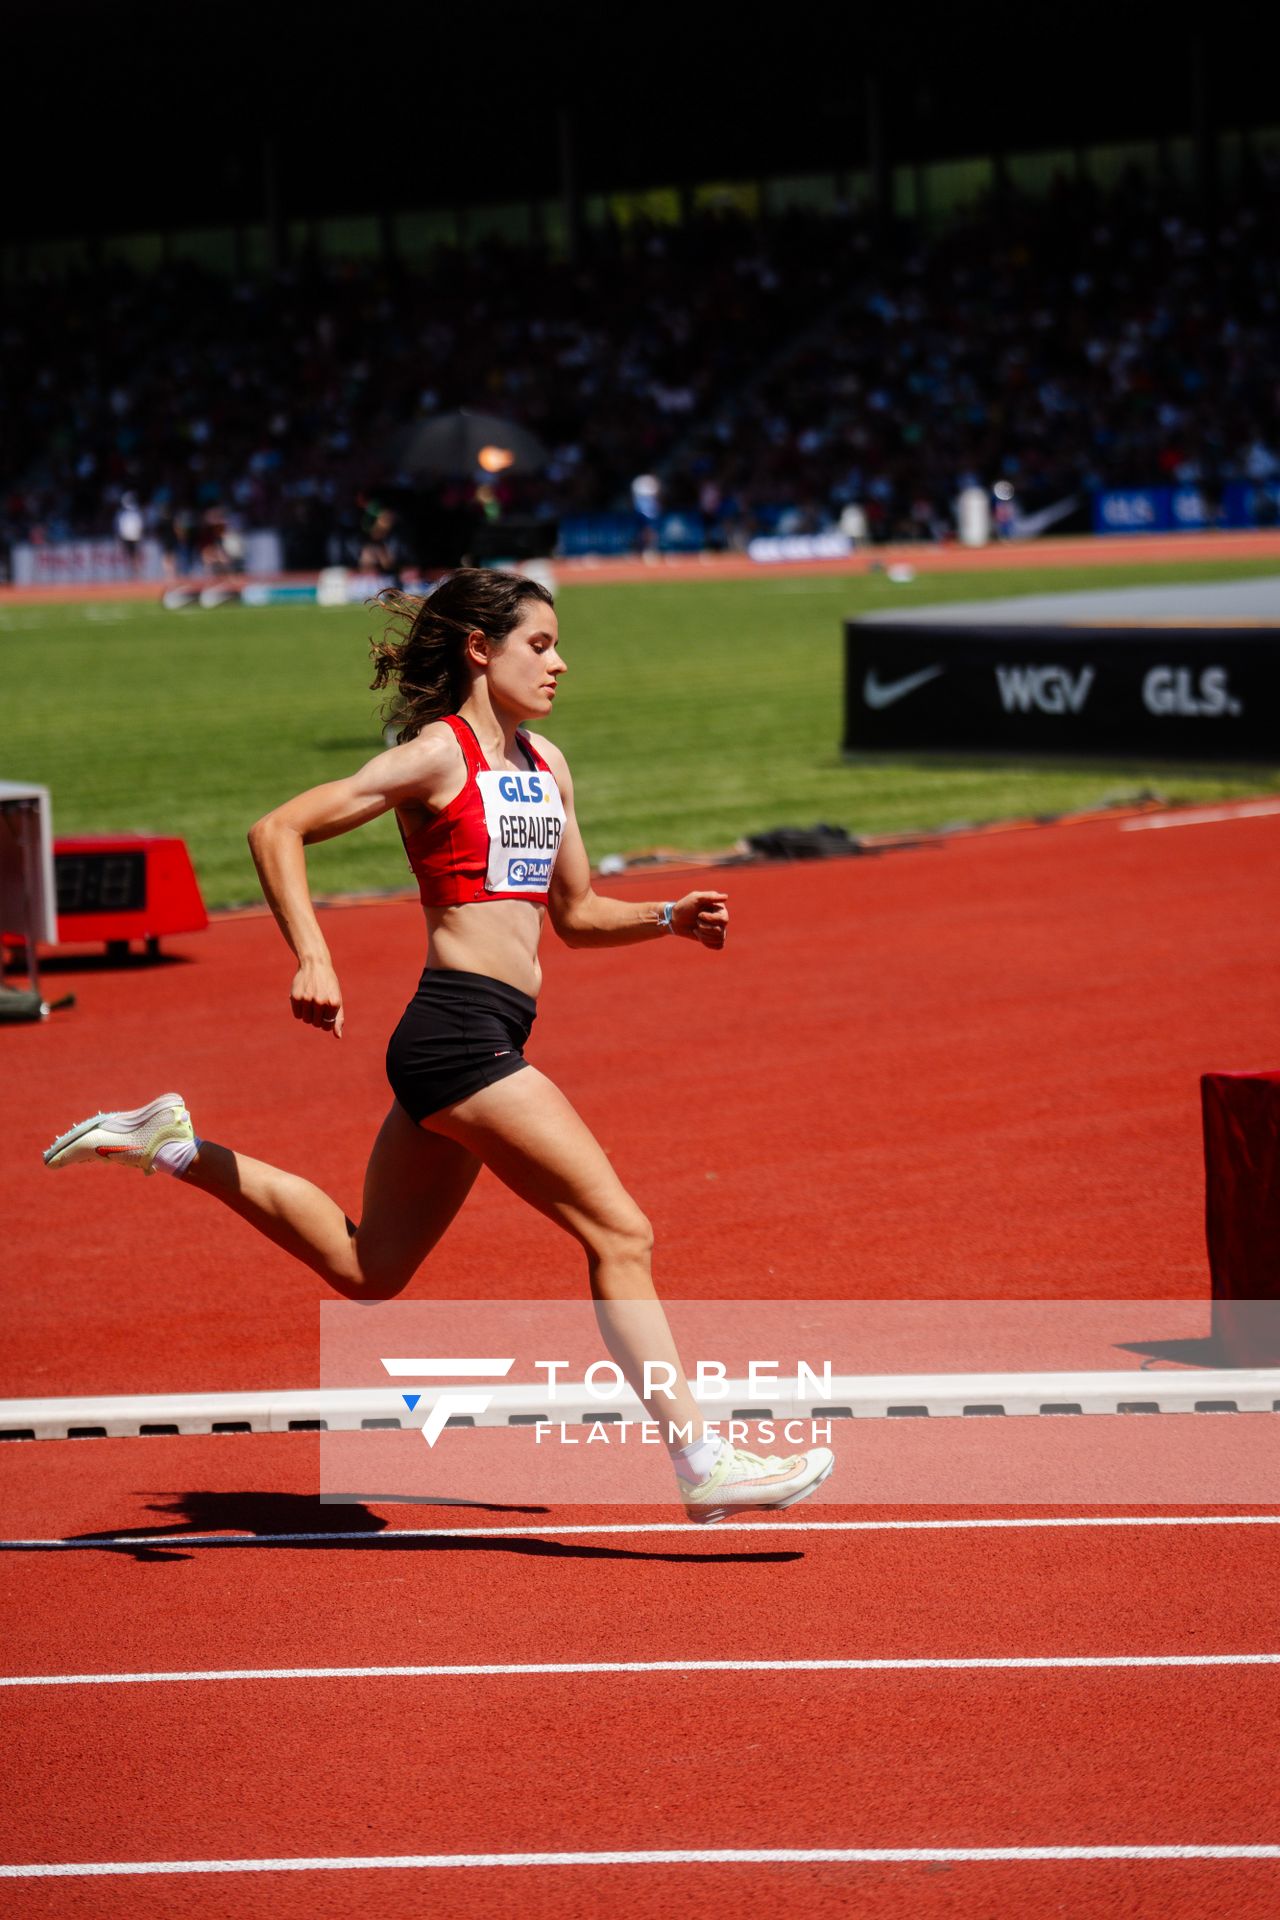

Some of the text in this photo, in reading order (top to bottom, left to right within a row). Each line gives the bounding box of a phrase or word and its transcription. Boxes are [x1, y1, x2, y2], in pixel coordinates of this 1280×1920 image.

[996, 664, 1094, 715] WGV
[1143, 665, 1241, 716] GLS.
[500, 815, 562, 850] GEBAUER
